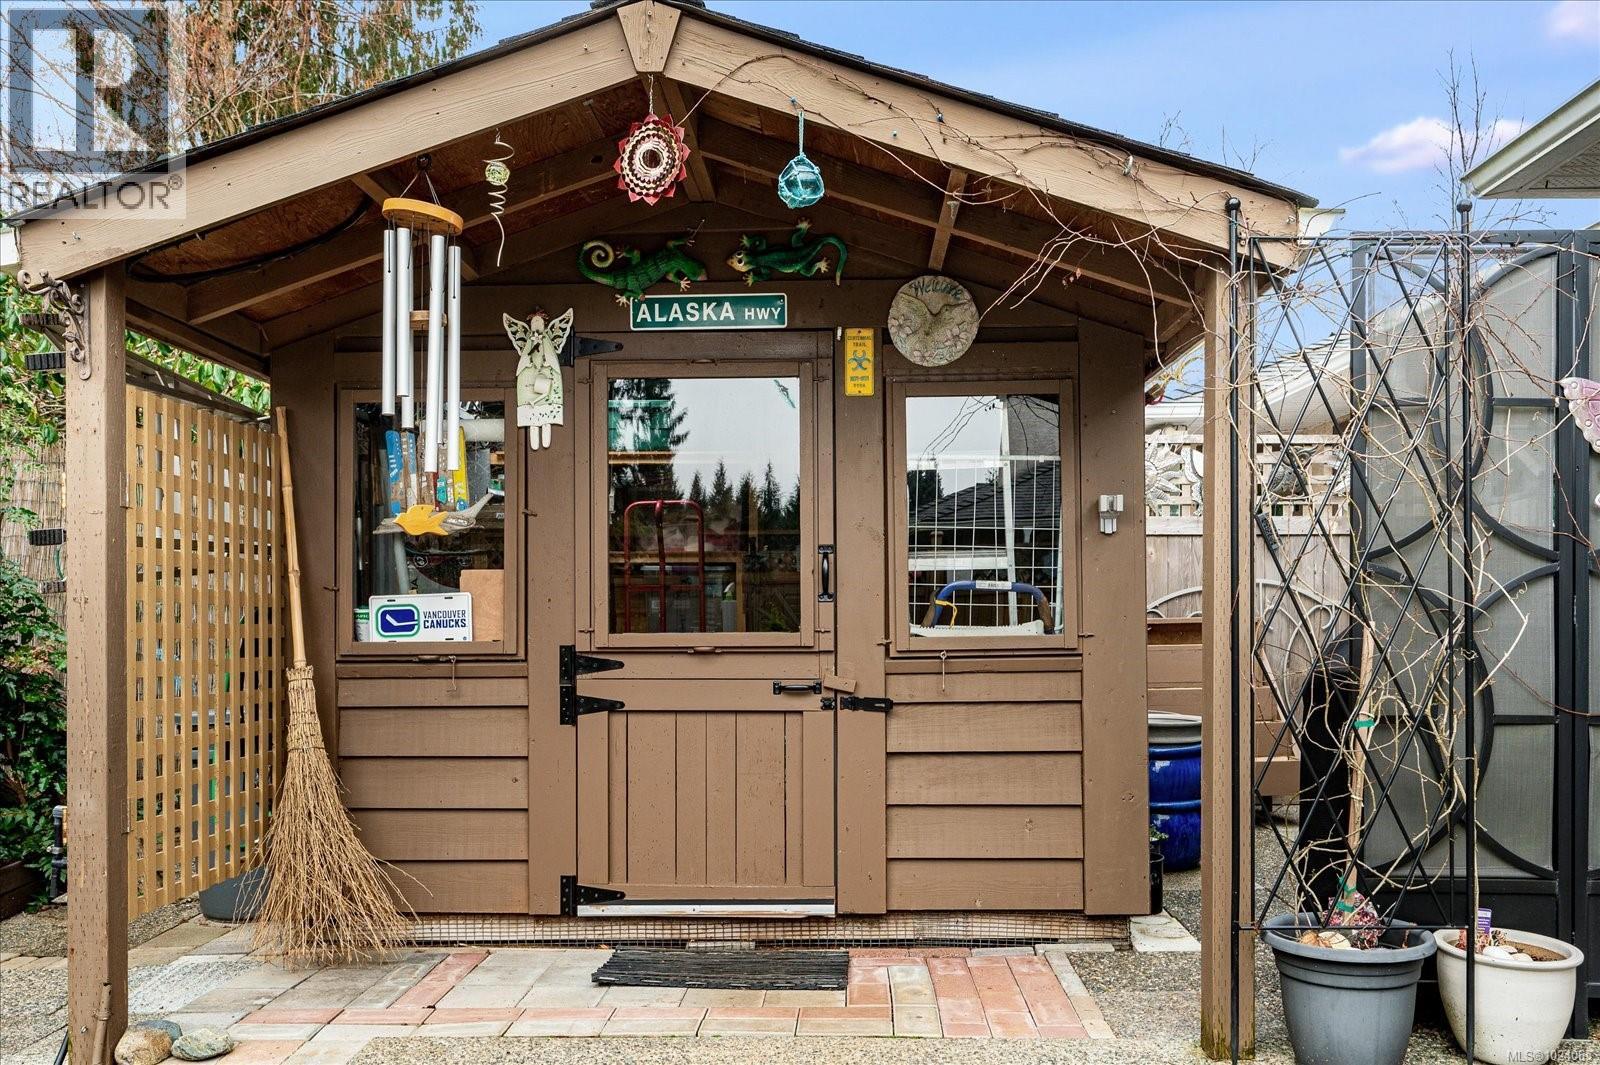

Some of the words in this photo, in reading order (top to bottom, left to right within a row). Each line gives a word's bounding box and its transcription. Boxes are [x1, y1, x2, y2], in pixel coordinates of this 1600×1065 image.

[636, 301, 736, 323] ALASKA
[744, 307, 781, 320] HWY
[423, 610, 466, 619] VANCOUVER
[423, 618, 466, 629] CANUCKS
